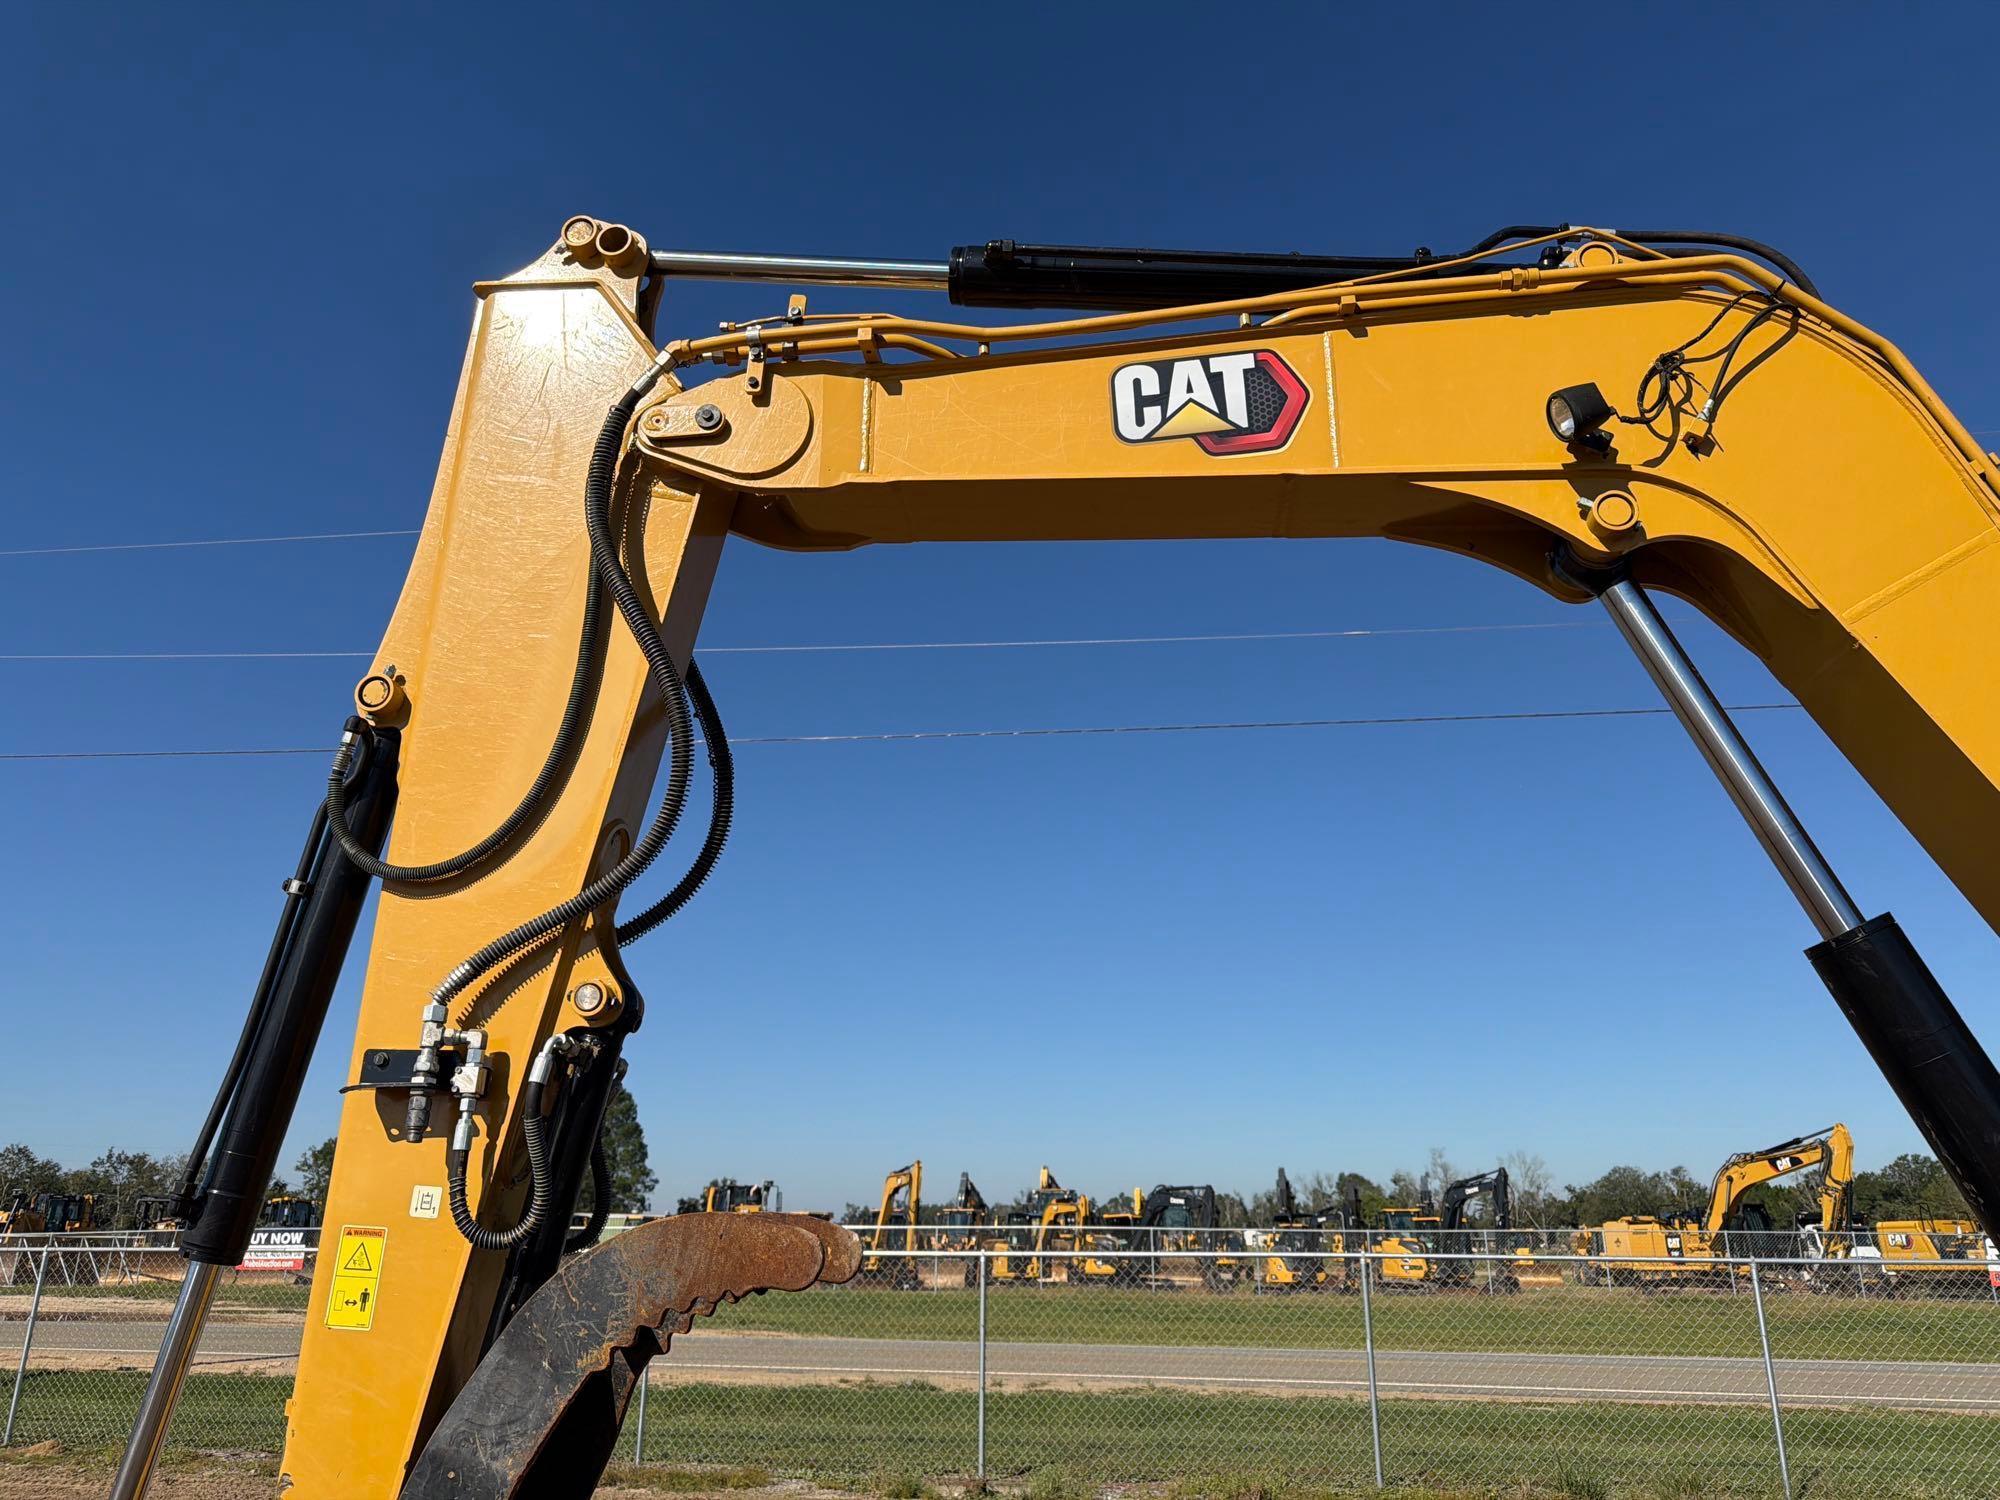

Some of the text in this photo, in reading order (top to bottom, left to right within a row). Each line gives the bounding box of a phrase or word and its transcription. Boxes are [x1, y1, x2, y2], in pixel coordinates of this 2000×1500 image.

[1114, 353, 1255, 440] CAT
[250, 1232, 304, 1244] UY NOW
[1887, 1233, 1907, 1246] CAT
